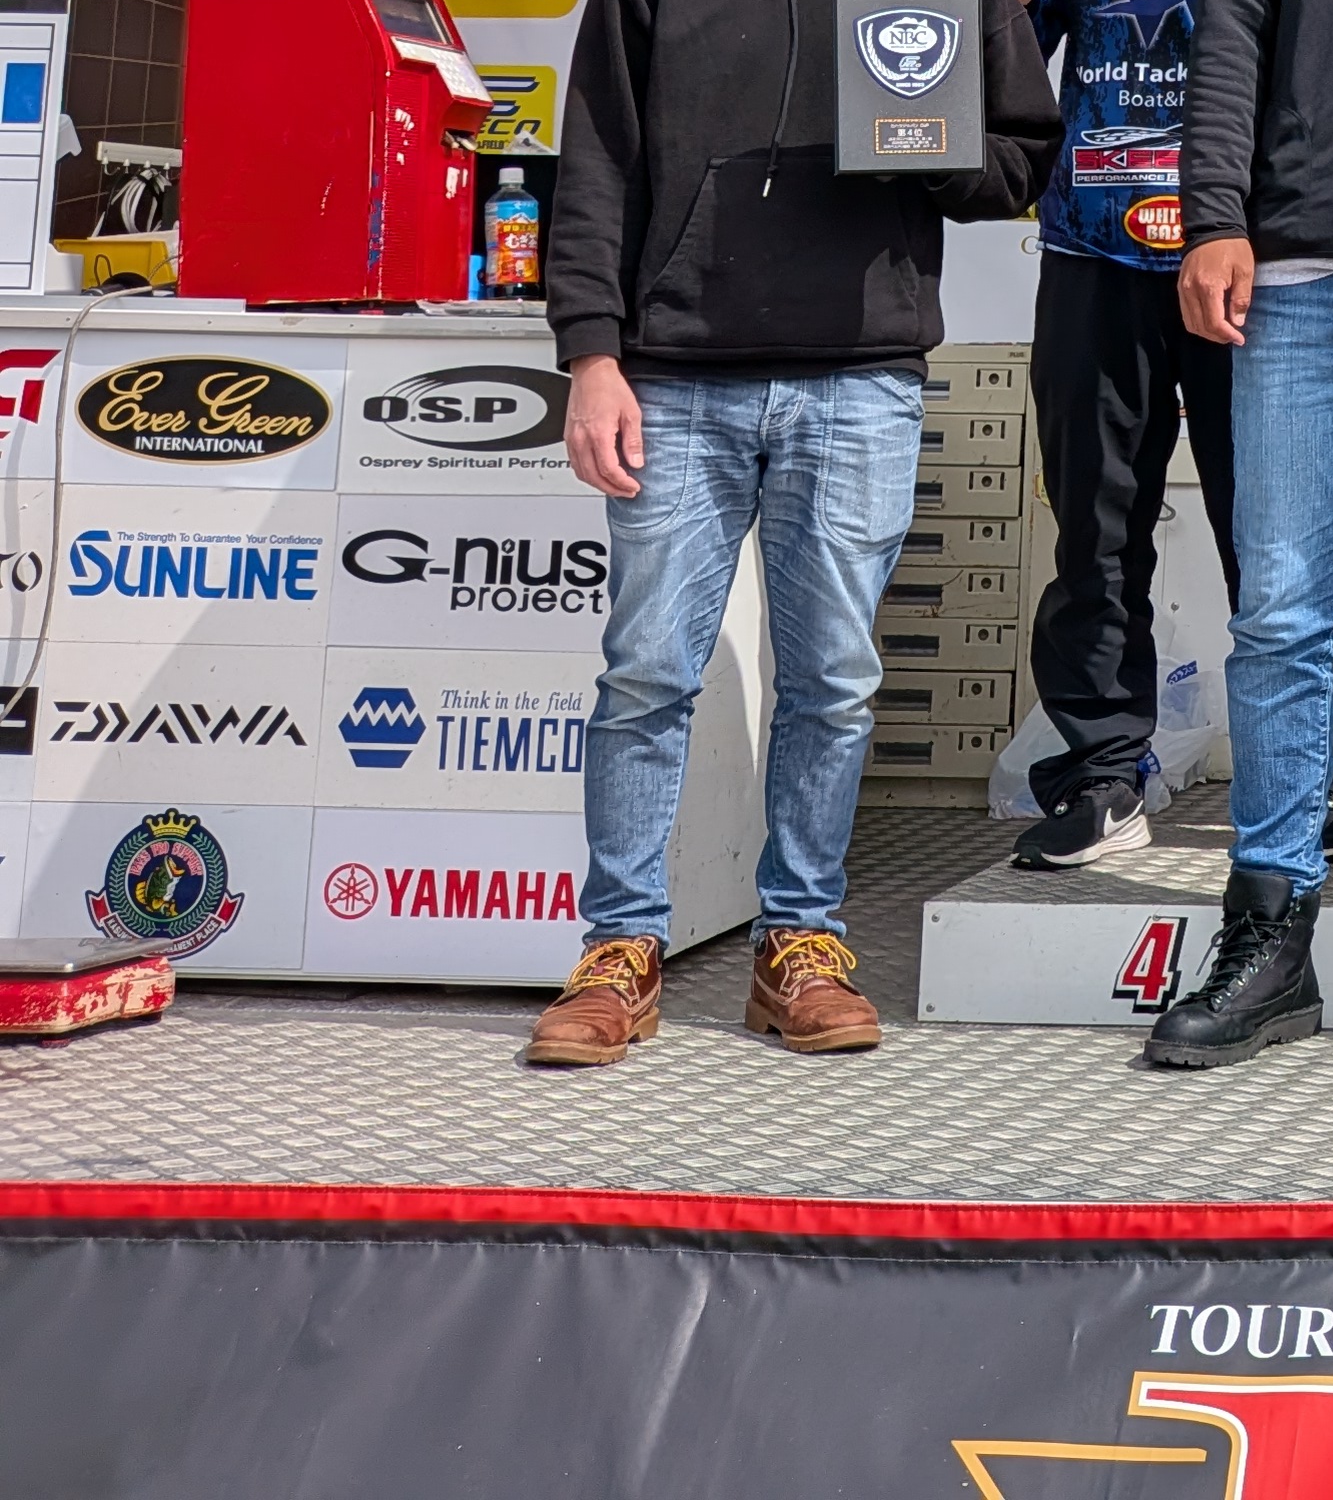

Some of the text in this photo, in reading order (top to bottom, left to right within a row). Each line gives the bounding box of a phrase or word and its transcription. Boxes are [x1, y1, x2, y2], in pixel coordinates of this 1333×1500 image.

[889, 31, 927, 45] NBC
[1077, 174, 1165, 182] PERFORMANCE
[99, 369, 312, 438] Ever Green
[135, 436, 266, 454] INTERNATIONAL
[359, 455, 423, 470] Osprey
[427, 454, 502, 470] Spiritual
[118, 531, 323, 545] The Strength To Guarantee Your Confidence
[69, 530, 320, 601] SUNLINE
[450, 582, 604, 614] project
[441, 689, 583, 714] Think in the field
[51, 702, 308, 746] DAIWA
[437, 715, 586, 772] TIEMCO
[385, 868, 577, 921] YAMAHA
[1113, 916, 1189, 1014] 4
